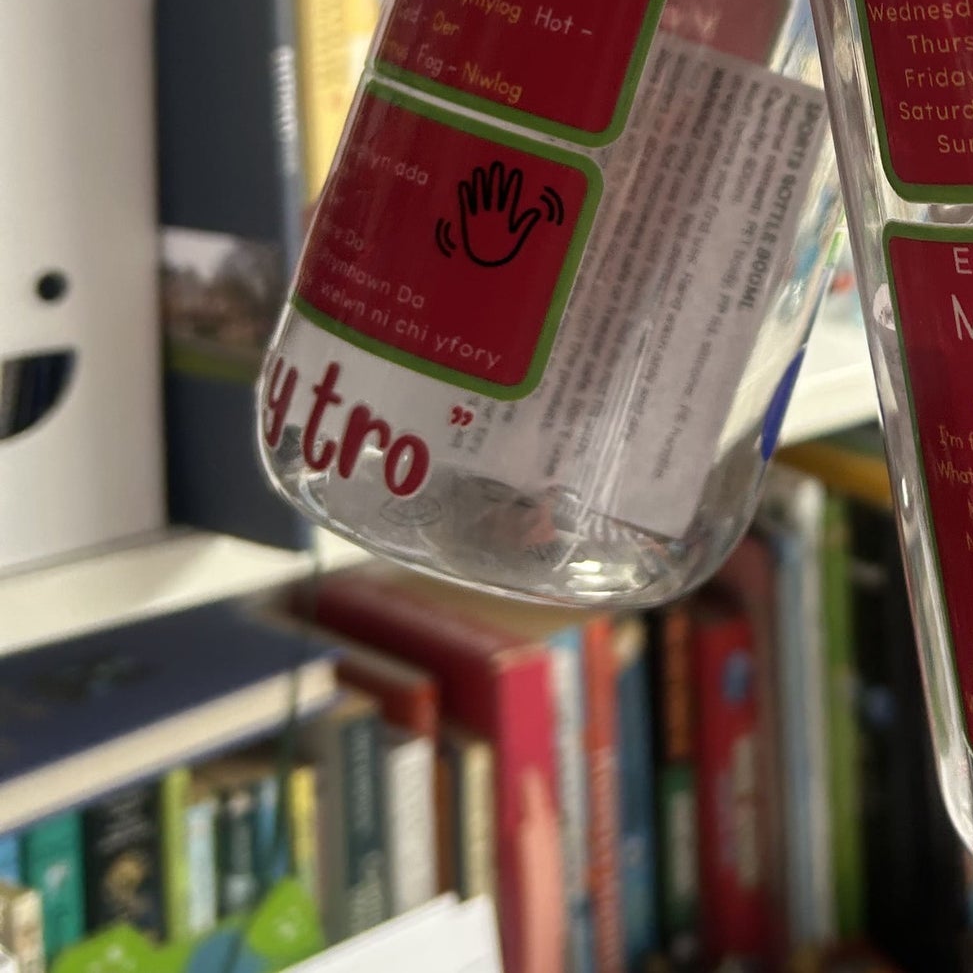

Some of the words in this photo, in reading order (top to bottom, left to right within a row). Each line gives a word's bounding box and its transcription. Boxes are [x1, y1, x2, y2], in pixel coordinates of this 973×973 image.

[534, 5, 574, 35] Hot
[417, 44, 444, 77] Fog
[462, 60, 524, 104] Niwlog
[397, 285, 425, 309] Da
[396, 317, 427, 342] chi
[434, 334, 503, 369] yfory
[302, 361, 431, 498] tro
